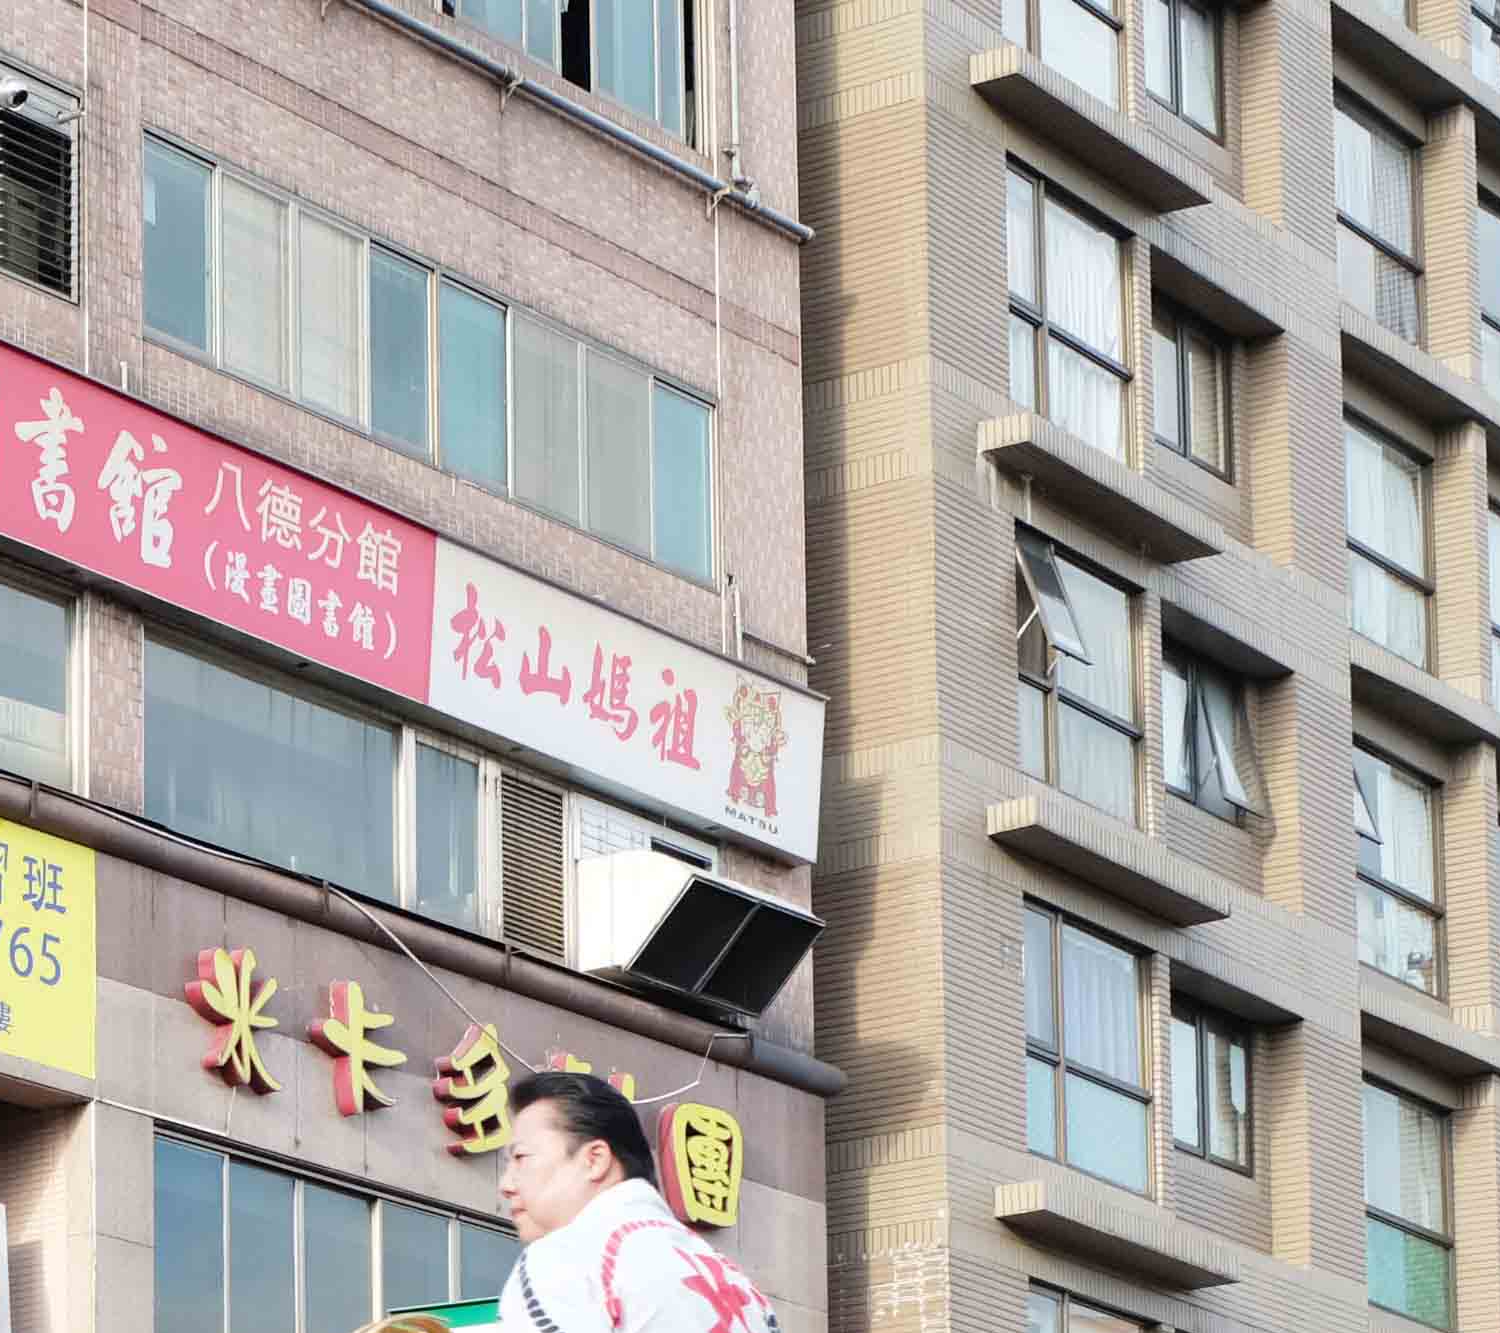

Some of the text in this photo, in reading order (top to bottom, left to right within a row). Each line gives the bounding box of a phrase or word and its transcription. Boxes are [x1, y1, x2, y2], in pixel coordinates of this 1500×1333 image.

[203, 459, 402, 595] 八德分館
[449, 582, 701, 771] 松山媽祖
[724, 804, 780, 837] MATSU
